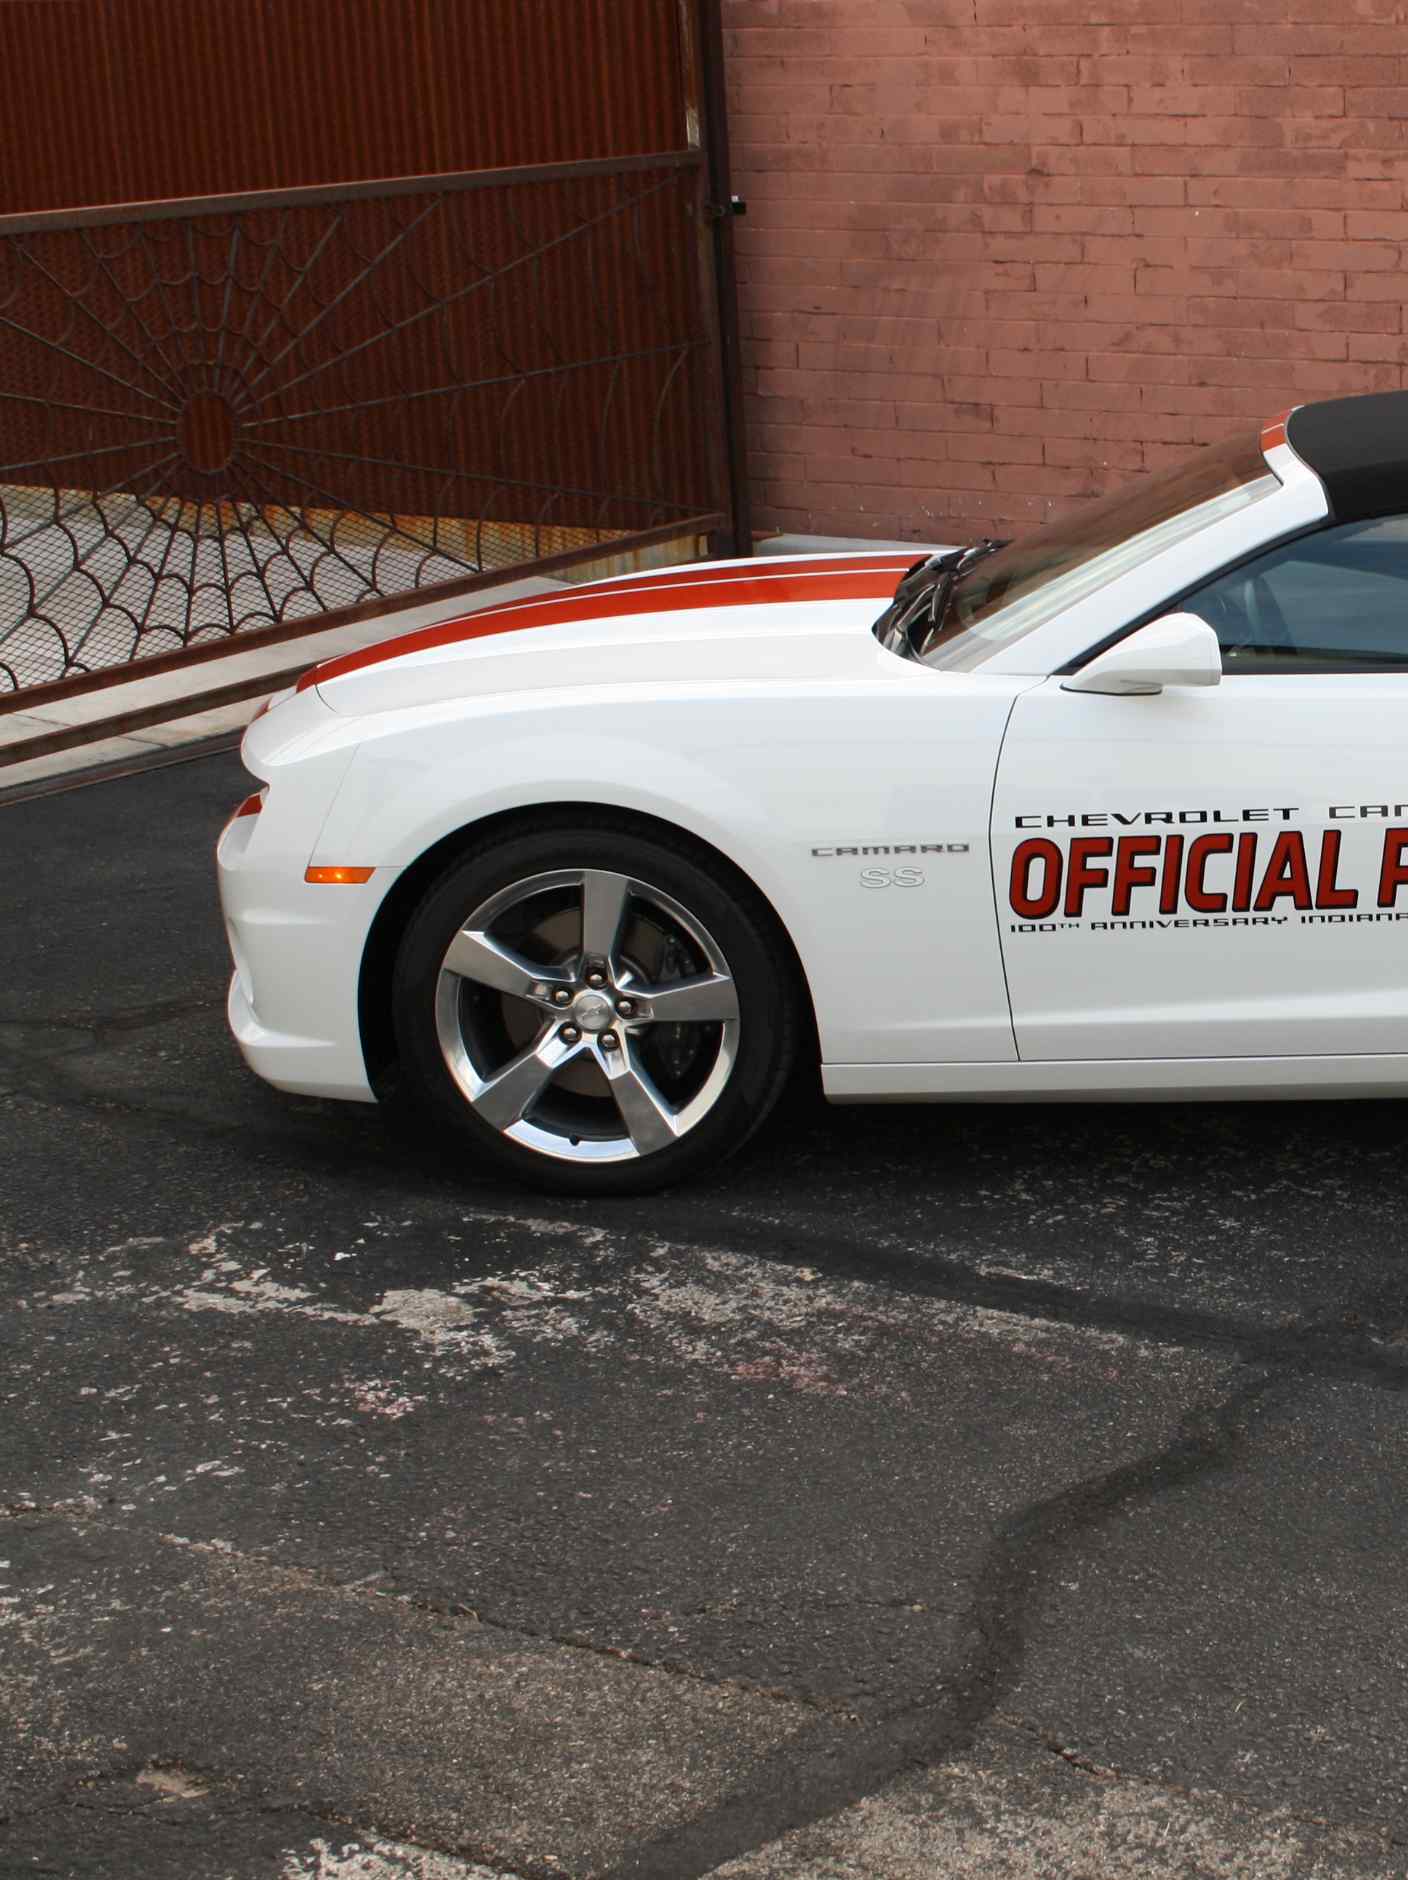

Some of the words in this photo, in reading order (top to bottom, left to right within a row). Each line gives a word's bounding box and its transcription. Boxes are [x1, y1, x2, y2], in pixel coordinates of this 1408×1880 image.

[1014, 807, 1302, 829] CHEVROLET
[811, 843, 970, 857] CAMARO
[860, 866, 925, 889] SS
[1008, 828, 1360, 921] OFFICIAL
[1010, 922, 1080, 934] 100TH
[1090, 917, 1290, 931] ANNIVERSARY
